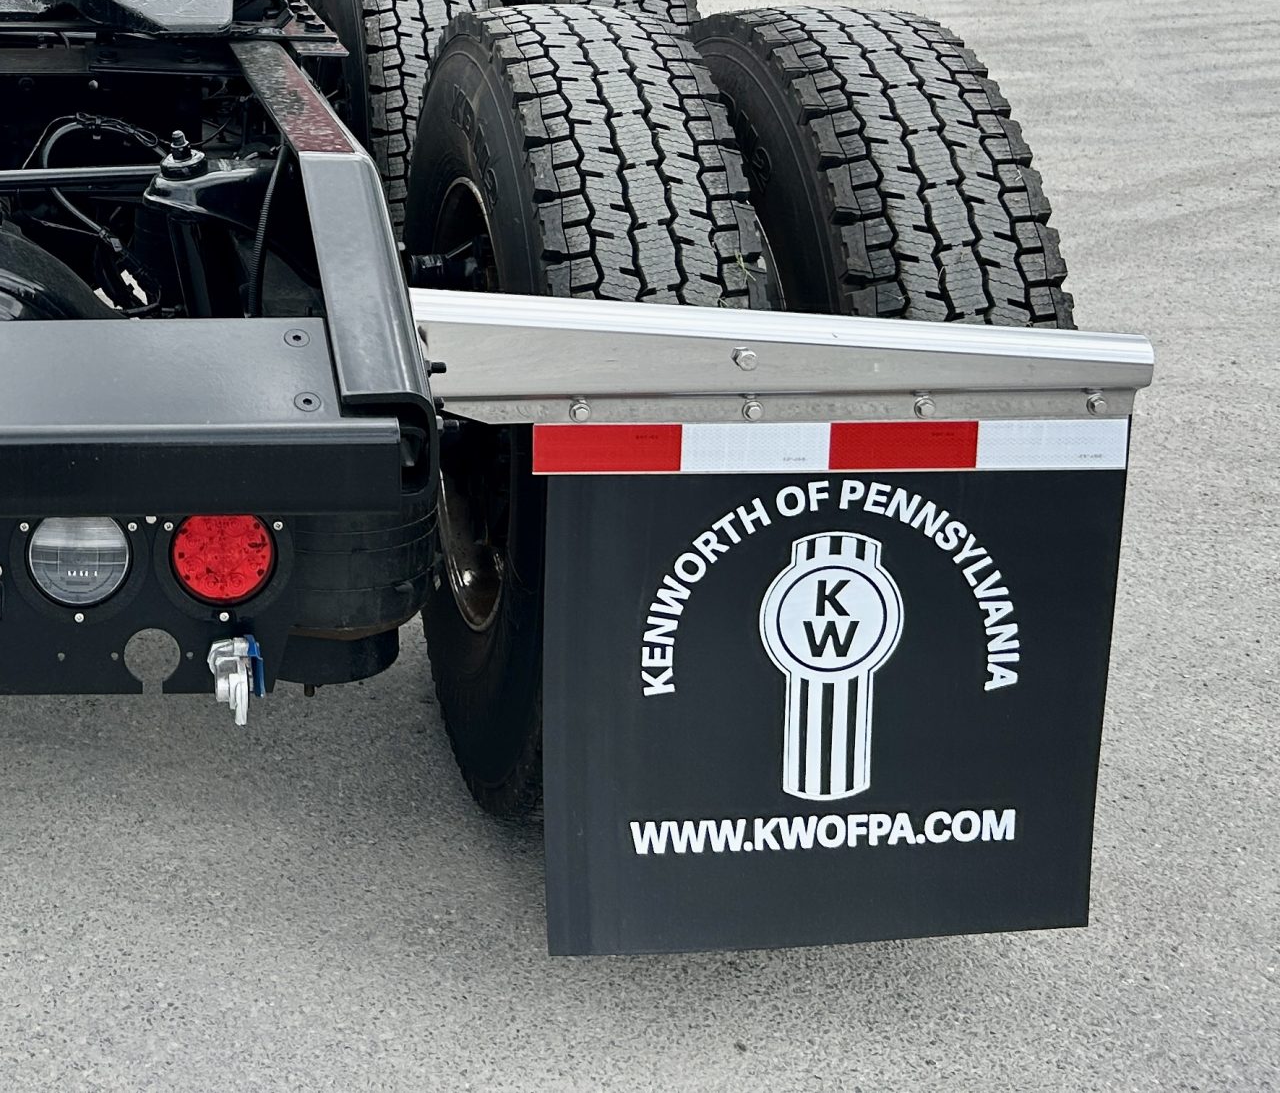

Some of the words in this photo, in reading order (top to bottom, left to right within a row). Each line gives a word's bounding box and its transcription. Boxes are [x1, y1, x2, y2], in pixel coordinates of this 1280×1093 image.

[642, 498, 771, 697] KENWORTH
[776, 481, 830, 516] OF
[840, 480, 1020, 691] PENNSYLVANIA
[816, 580, 851, 617] K
[803, 620, 860, 658] W
[630, 809, 1016, 855] WWW.KWOFPA.COM
